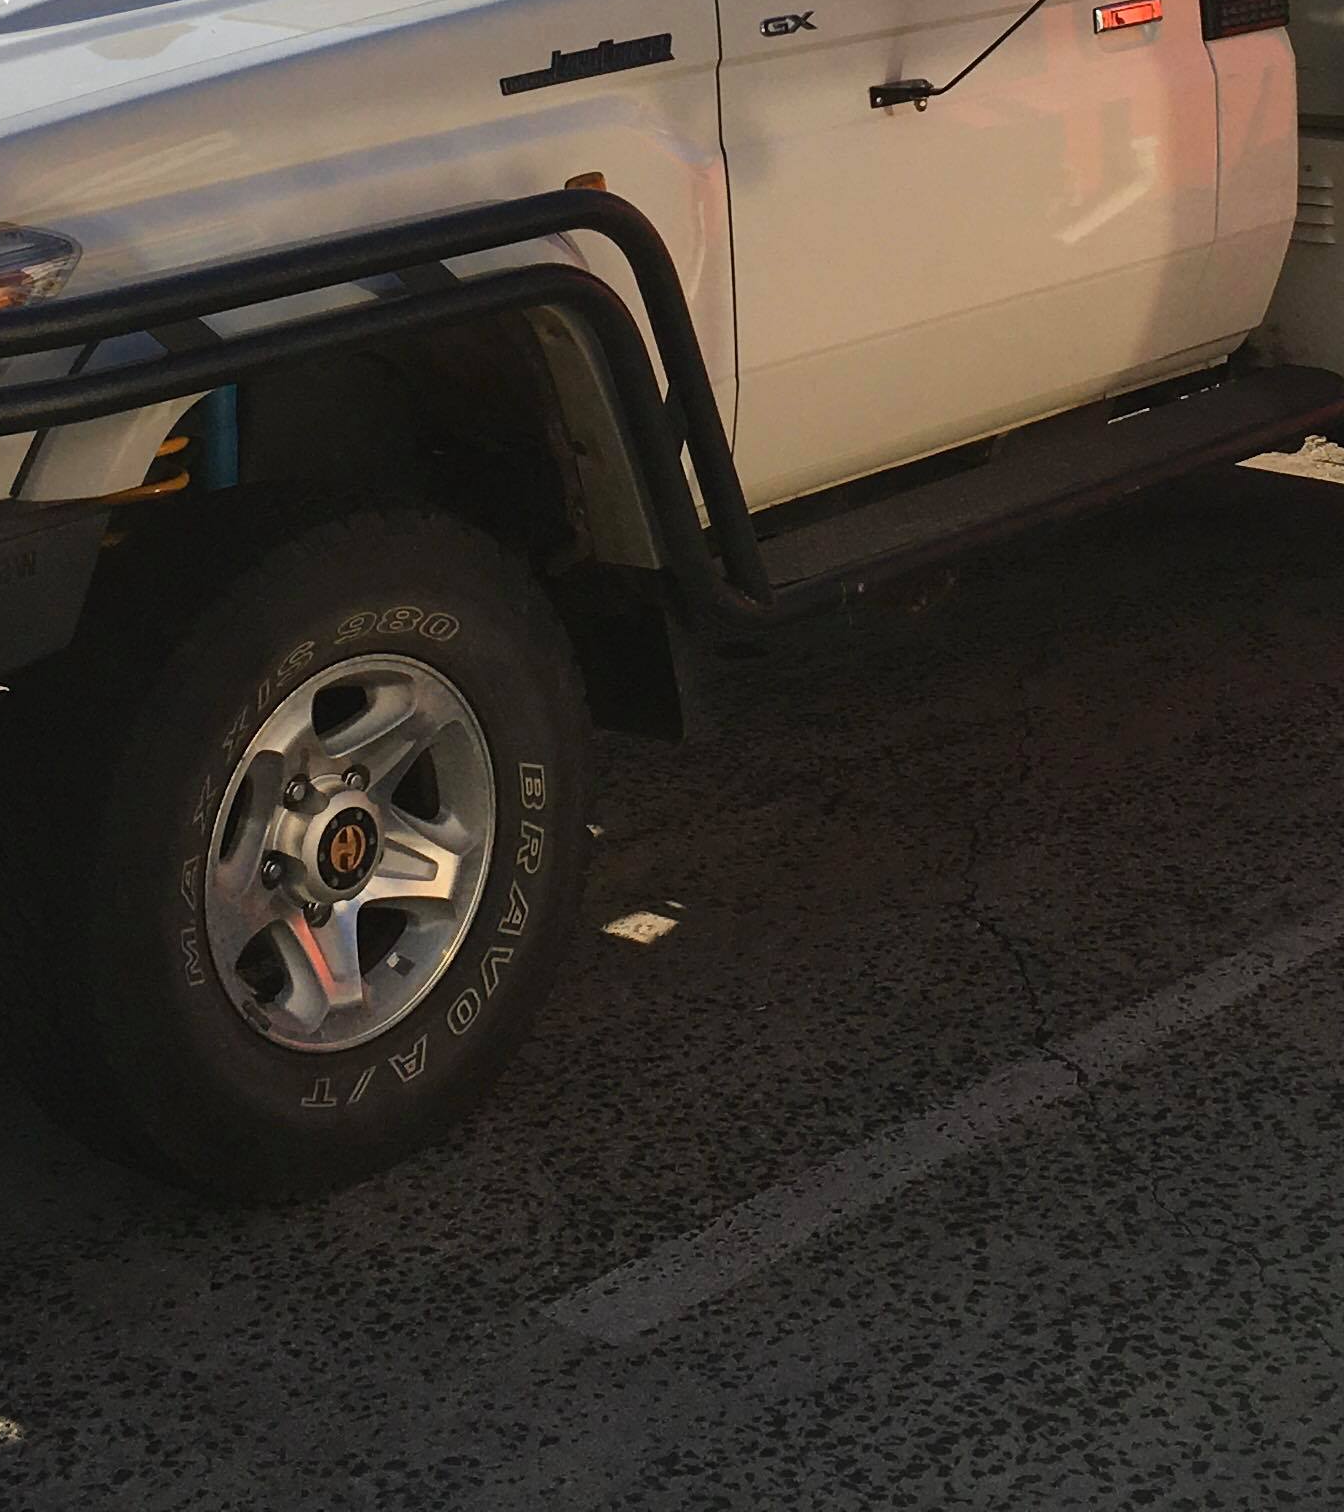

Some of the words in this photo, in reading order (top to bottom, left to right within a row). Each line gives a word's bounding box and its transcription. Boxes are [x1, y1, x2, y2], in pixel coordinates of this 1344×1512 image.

[759, 10, 818, 37] GX
[333, 606, 460, 646] 980
[447, 762, 547, 1035] BRAVO
[301, 1033, 428, 1107] A/T
